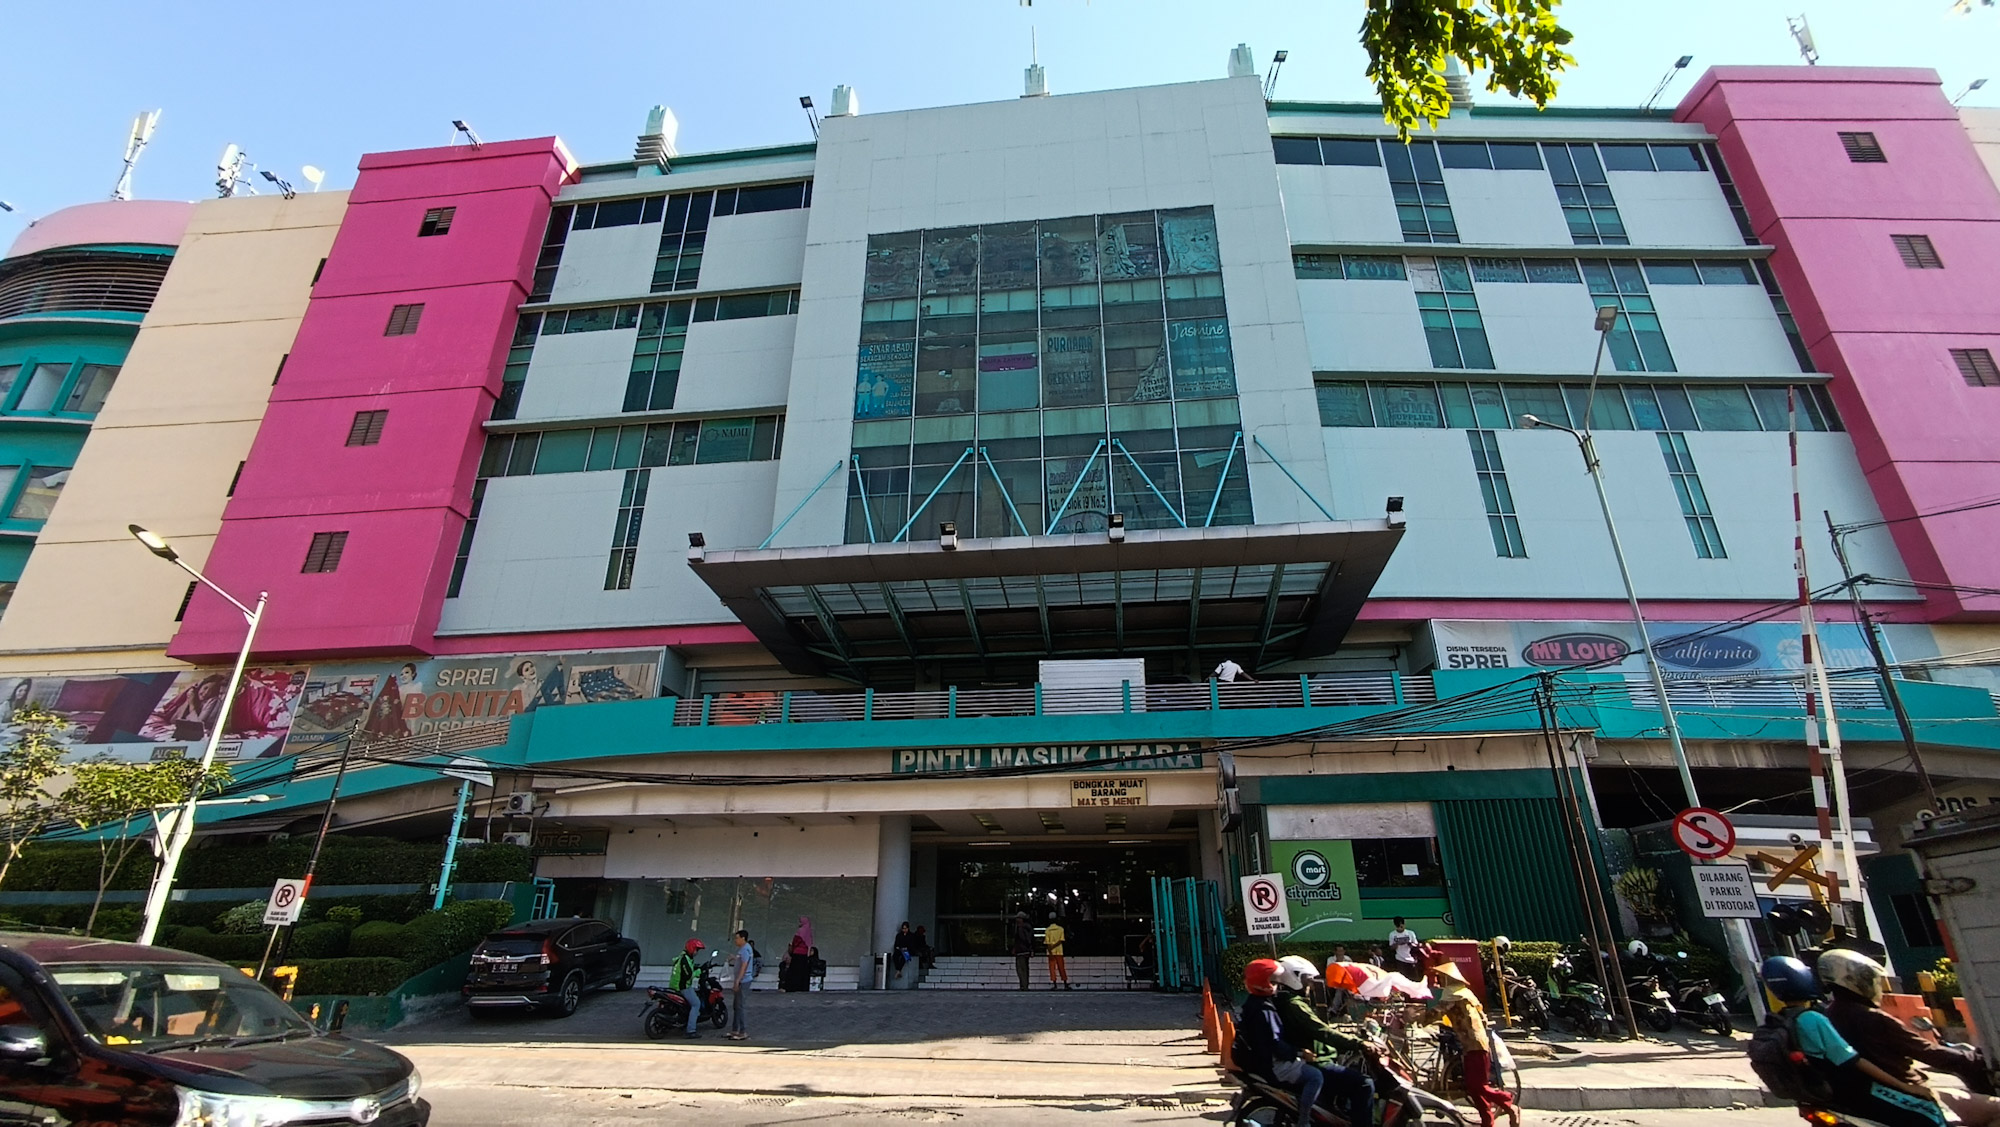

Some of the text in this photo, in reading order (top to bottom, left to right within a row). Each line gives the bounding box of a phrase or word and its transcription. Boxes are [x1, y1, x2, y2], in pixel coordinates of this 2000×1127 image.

[1169, 323, 1225, 342] Jasmine
[891, 342, 914, 353] ABADI
[1532, 641, 1623, 660] MY LOVE
[1654, 641, 1755, 666] California
[1449, 653, 1510, 669] SPREI
[436, 667, 499, 687] SPREI
[401, 689, 525, 720] BONITA
[291, 734, 325, 743] DIJAMIN
[900, 743, 1197, 772] PINTU MASUK UTARA
[1073, 780, 1144, 789] BONGKAR MUAT
[1091, 788, 1127, 797] BARANG
[1077, 797, 1141, 806] MAX 15 MENIT
[1305, 865, 1326, 874] mart
[1700, 872, 1744, 882] DILARANG
[1709, 886, 1742, 896] PARKIR
[1704, 900, 1756, 911] DI TROTOAR
